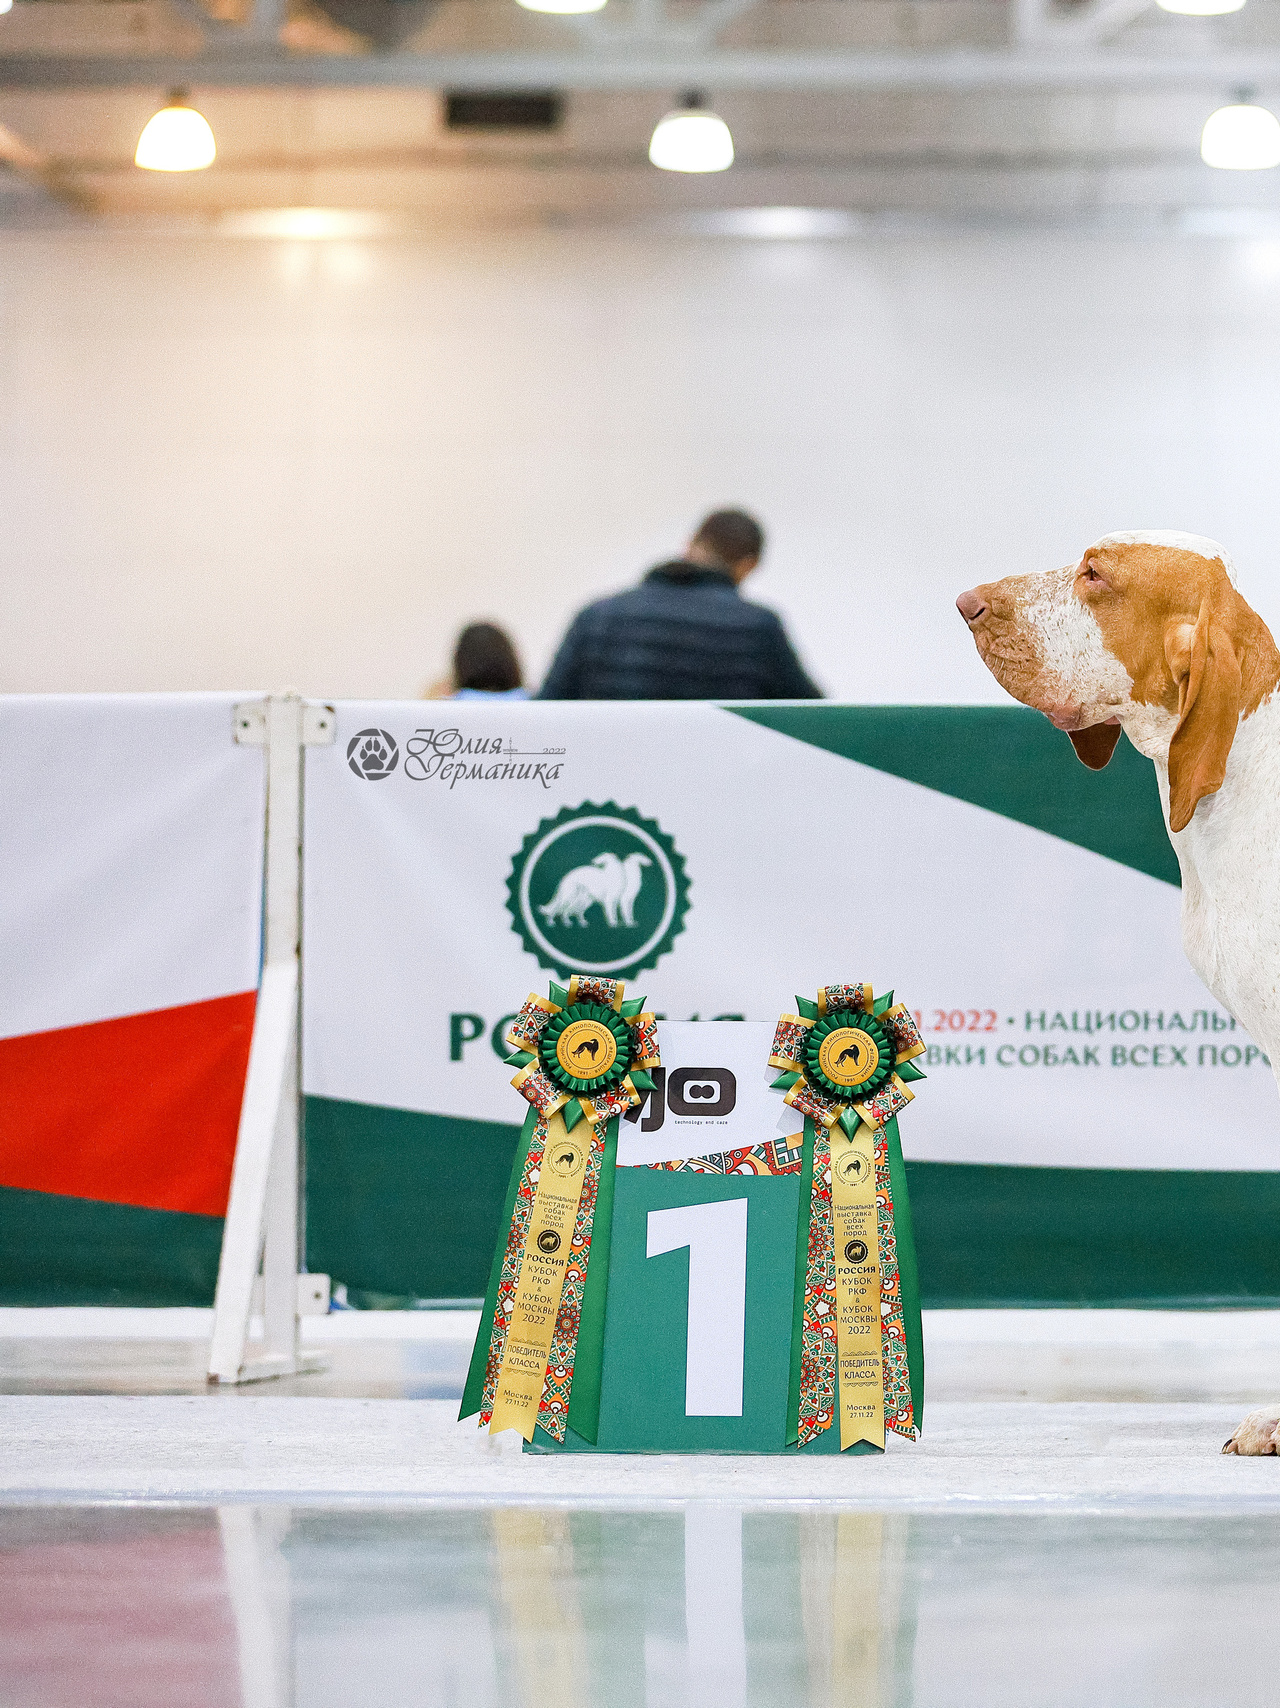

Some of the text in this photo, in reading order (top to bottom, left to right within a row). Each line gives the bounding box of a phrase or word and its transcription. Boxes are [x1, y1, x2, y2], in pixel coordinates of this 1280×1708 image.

[914, 1043, 986, 1067] ВКИ
[995, 1044, 1100, 1068] СОБАК
[1111, 1044, 1188, 1068] ВСЕХ
[538, 1200, 573, 1211] выставка
[543, 1207, 566, 1216] собак
[836, 1210, 872, 1218] выставка
[545, 1213, 562, 1221] всех
[843, 1217, 866, 1225] собак
[540, 1219, 564, 1229] пород
[843, 1230, 867, 1238] пород
[526, 1253, 565, 1267] РОССИЯ
[527, 1265, 559, 1277] КУБОК
[838, 1266, 876, 1275] РОССИЯ
[531, 1275, 551, 1285] РКФ
[841, 1277, 873, 1286] КУБОК
[848, 1287, 867, 1296] РКФ
[522, 1292, 553, 1305] КУБОК
[517, 1302, 555, 1316] МОСКВЫ
[646, 1197, 749, 1417] 1
[842, 1304, 873, 1314] КУБОК
[522, 1313, 546, 1325] 2022
[839, 1315, 878, 1324] МОСКВЫ
[847, 1325, 871, 1335] 2022
[507, 1344, 547, 1359] ПОБЕДИТЕЛЬ
[508, 1357, 540, 1370] КЛАССА
[839, 1358, 880, 1369] ПОБЕДИТЕЛЬ
[844, 1370, 876, 1379] КЛАССА
[503, 1389, 533, 1401] Москва
[505, 1398, 529, 1408] 27.11.22
